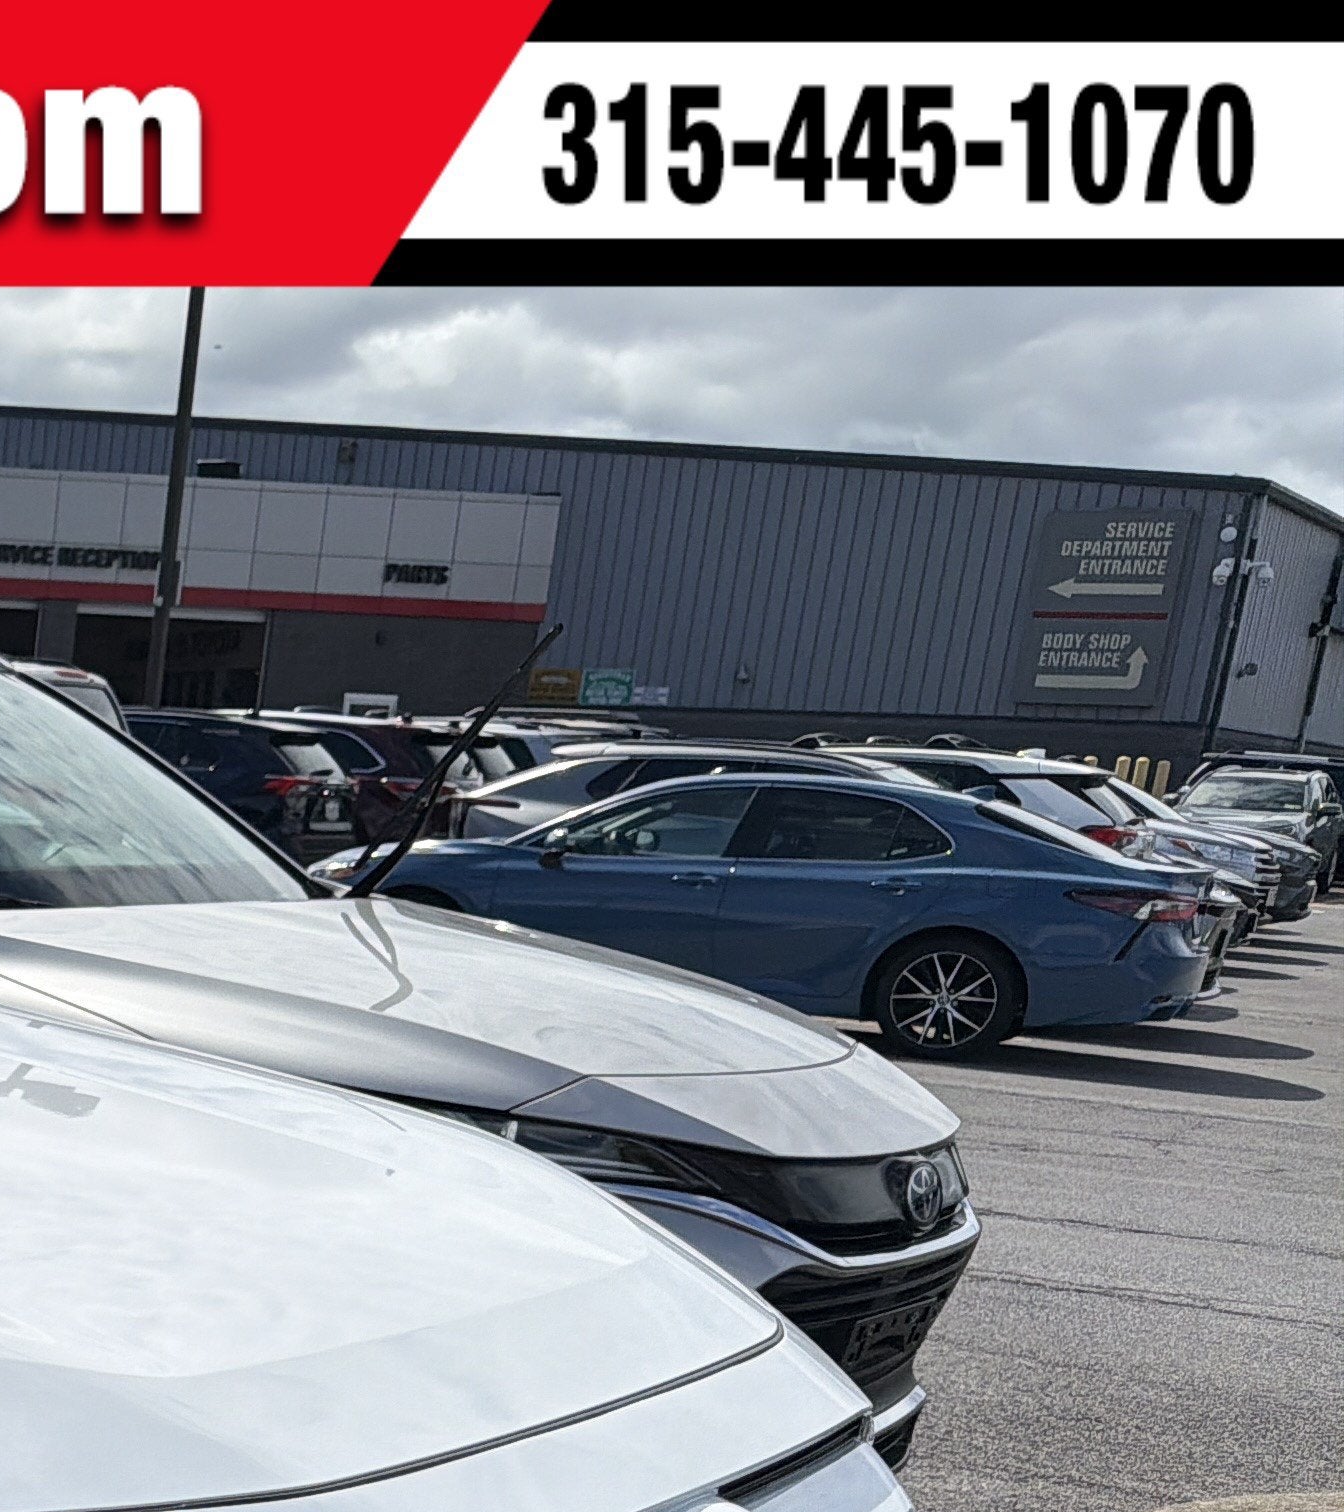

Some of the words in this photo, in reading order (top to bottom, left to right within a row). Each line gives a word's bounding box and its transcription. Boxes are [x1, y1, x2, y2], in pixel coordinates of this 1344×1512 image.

[1105, 521, 1175, 538] SERVICE
[1061, 540, 1172, 557] DEPARTMENT
[1078, 559, 1168, 576] ENTRANCE
[1042, 632, 1085, 649] BODY
[1088, 633, 1132, 650] SHOP
[1038, 650, 1122, 667] ENTRANCE
